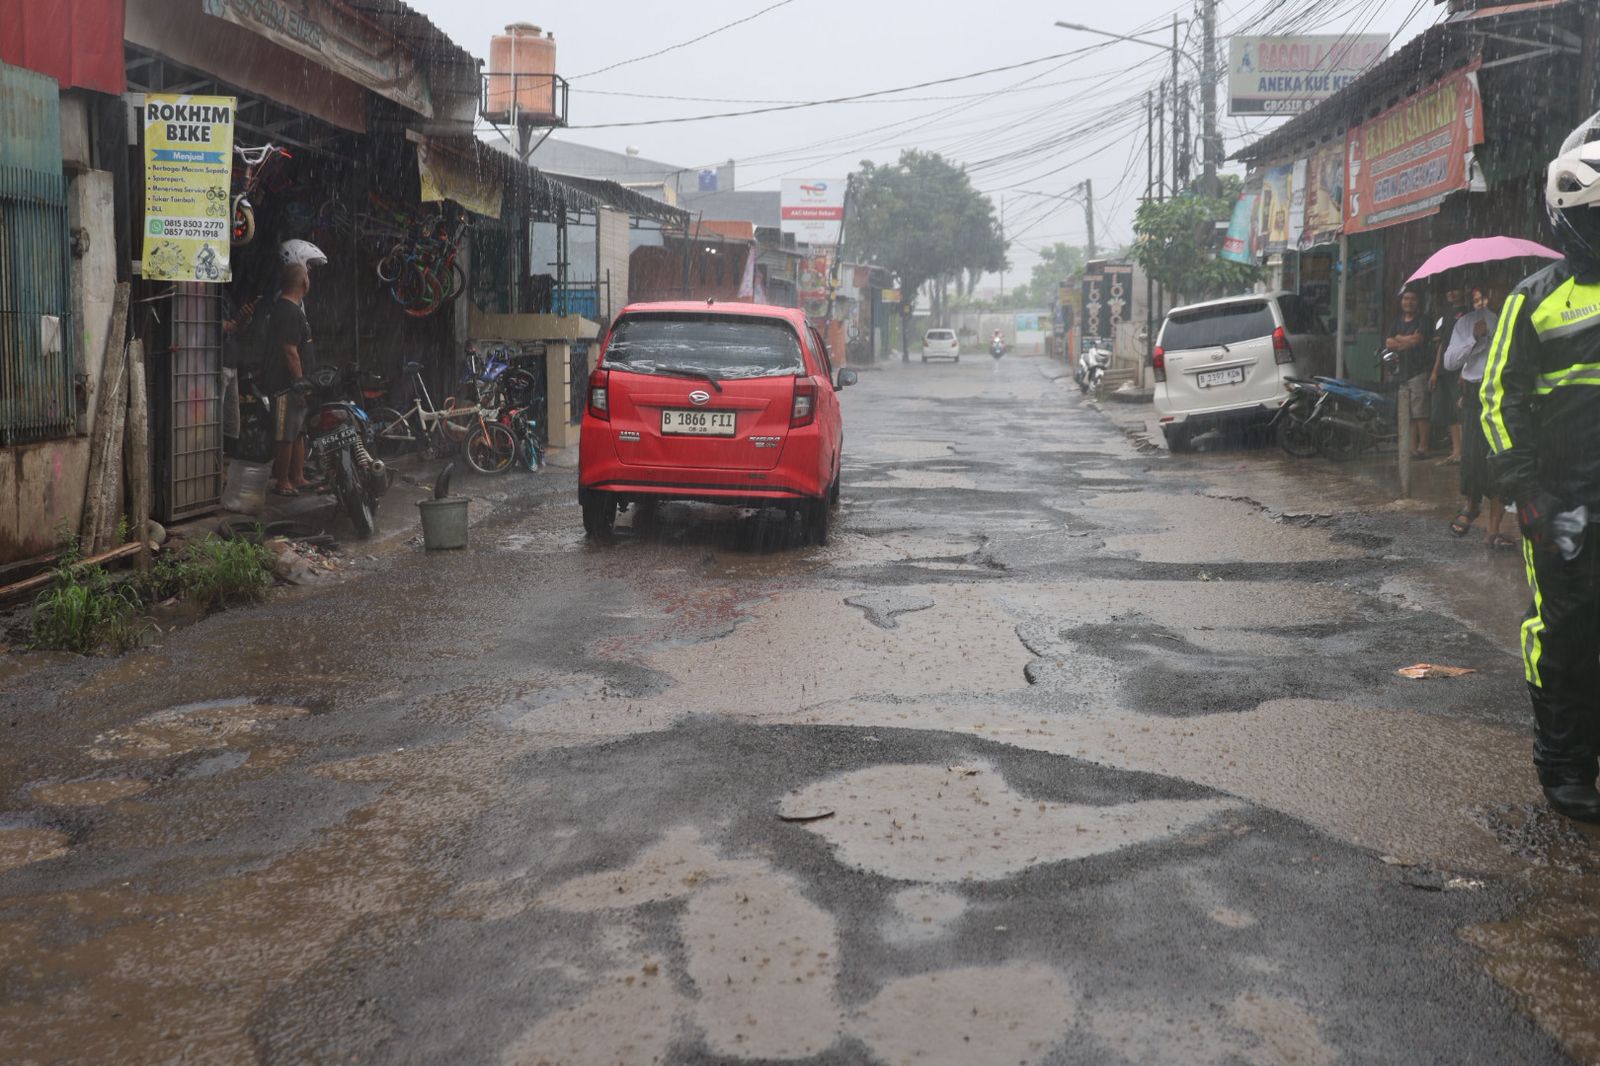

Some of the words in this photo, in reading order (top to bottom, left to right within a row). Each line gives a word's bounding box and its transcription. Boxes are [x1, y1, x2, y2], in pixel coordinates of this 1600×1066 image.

[1258, 76, 1302, 92] ANEKA
[1305, 75, 1329, 91] KUE
[147, 103, 230, 124] ROKHIM
[166, 124, 211, 142] BIKE
[173, 151, 205, 162] Menjual
[152, 165, 180, 173] Berbagai
[206, 167, 229, 175] Sepeda
[152, 185, 183, 193] Menerima
[171, 196, 196, 204] Tambah
[164, 219, 181, 227] 0815
[183, 220, 202, 228] 8503
[204, 221, 224, 229] 2770
[164, 228, 183, 236] 0857
[184, 229, 200, 237] 1071
[202, 230, 218, 238] 1918
[664, 413, 671, 425] B
[678, 413, 706, 426] 1866
[711, 414, 733, 427] FII
